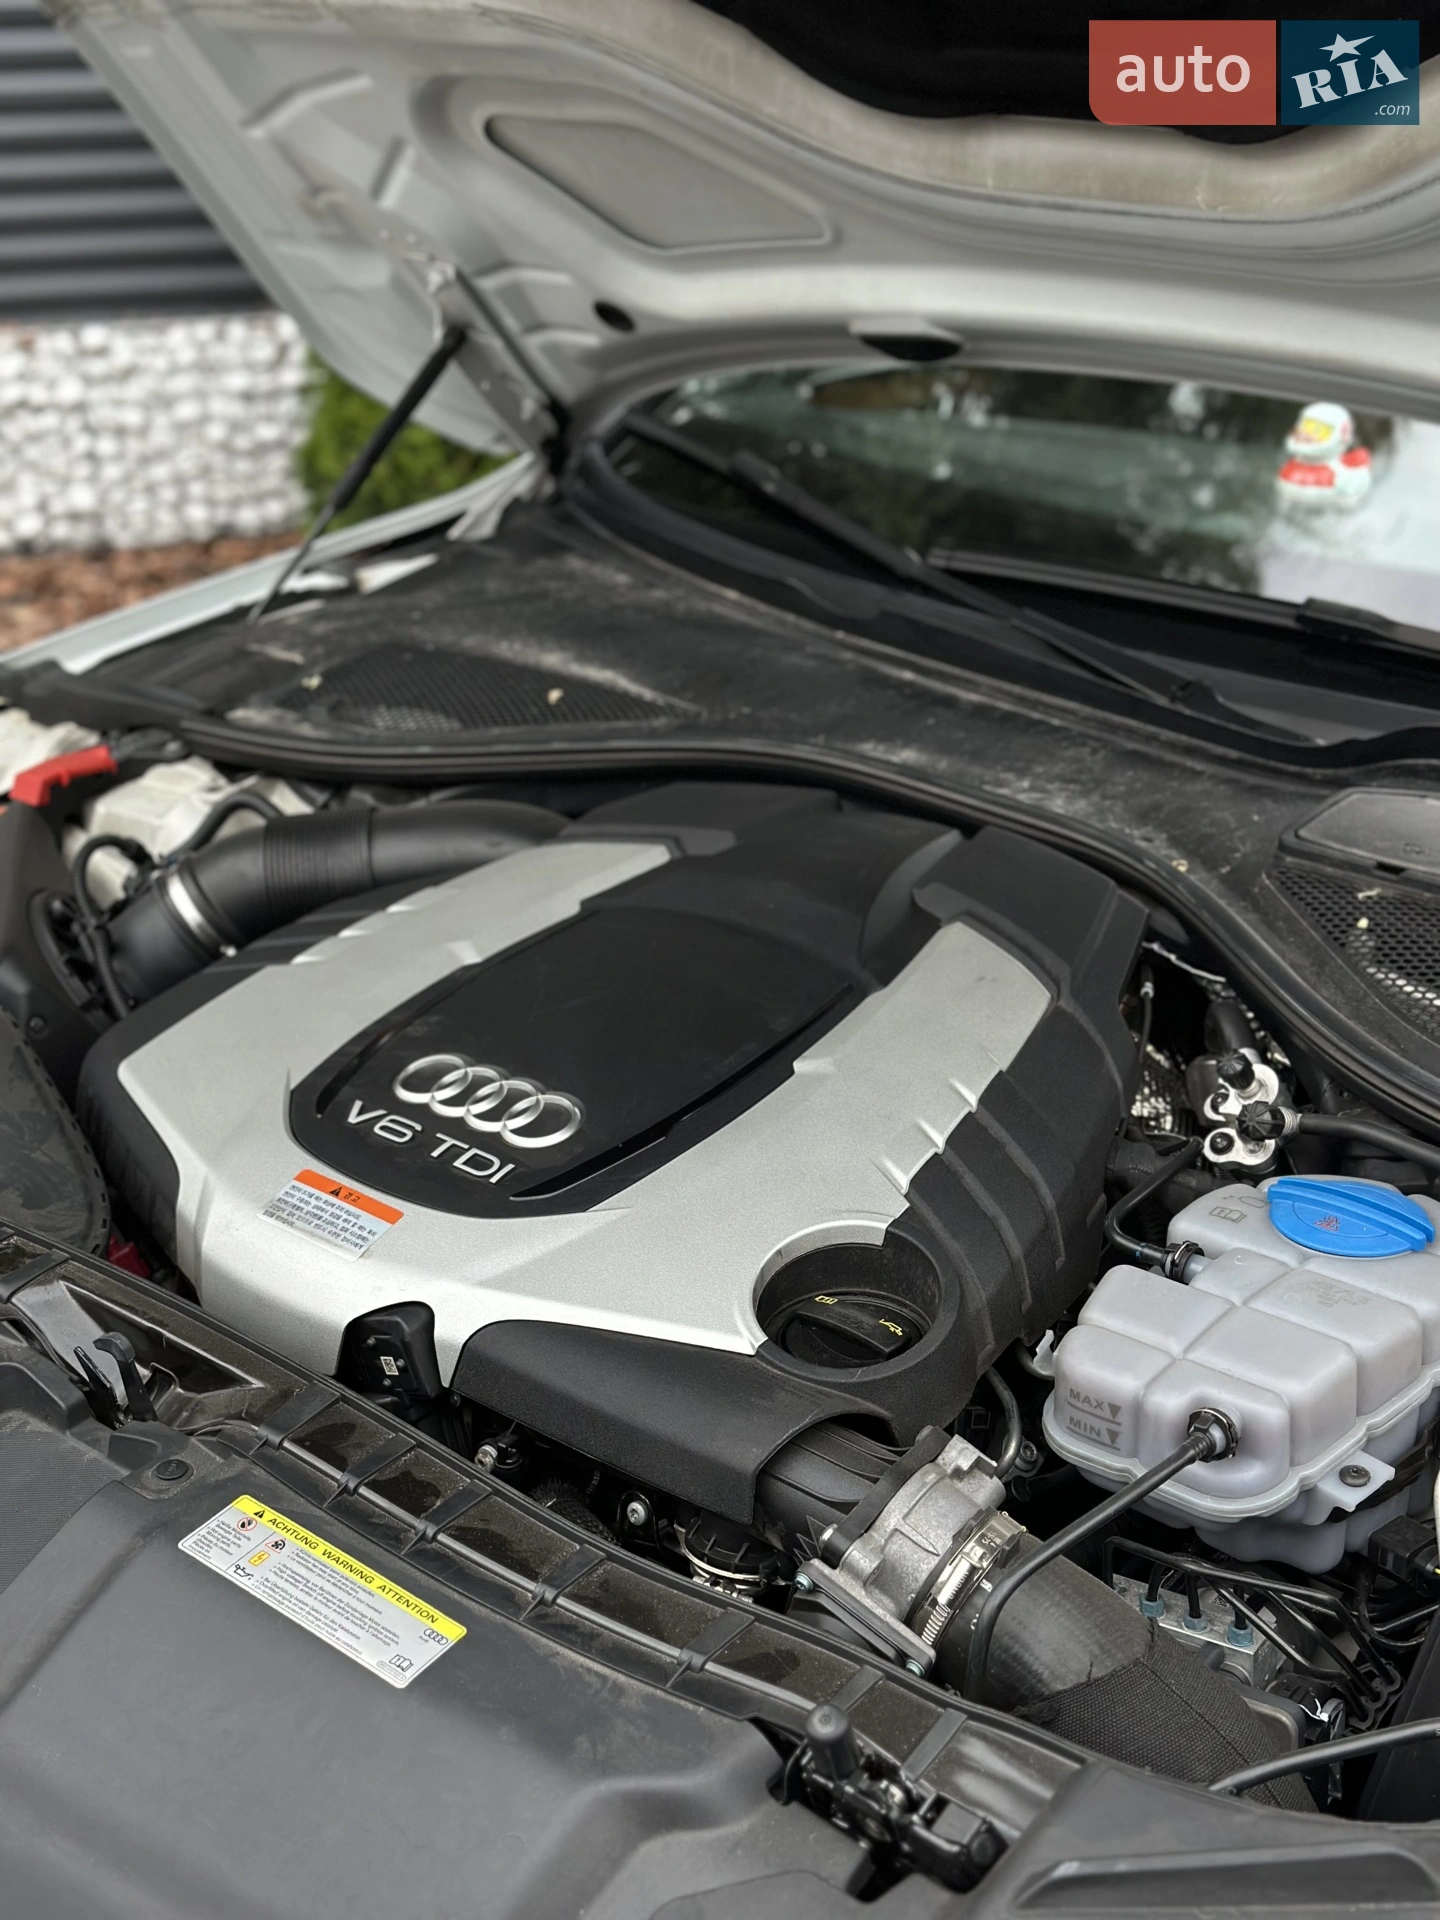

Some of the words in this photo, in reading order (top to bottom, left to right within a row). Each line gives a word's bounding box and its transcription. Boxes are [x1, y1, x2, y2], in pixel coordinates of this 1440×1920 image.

[346, 1099, 423, 1144] V6
[430, 1132, 516, 1184] TDI
[1069, 1387, 1104, 1412] MAX
[1069, 1415, 1101, 1438] MIN
[267, 1516, 319, 1550] ACHTUNG
[320, 1549, 375, 1584] WARNING
[376, 1583, 439, 1623] ATTENTION
